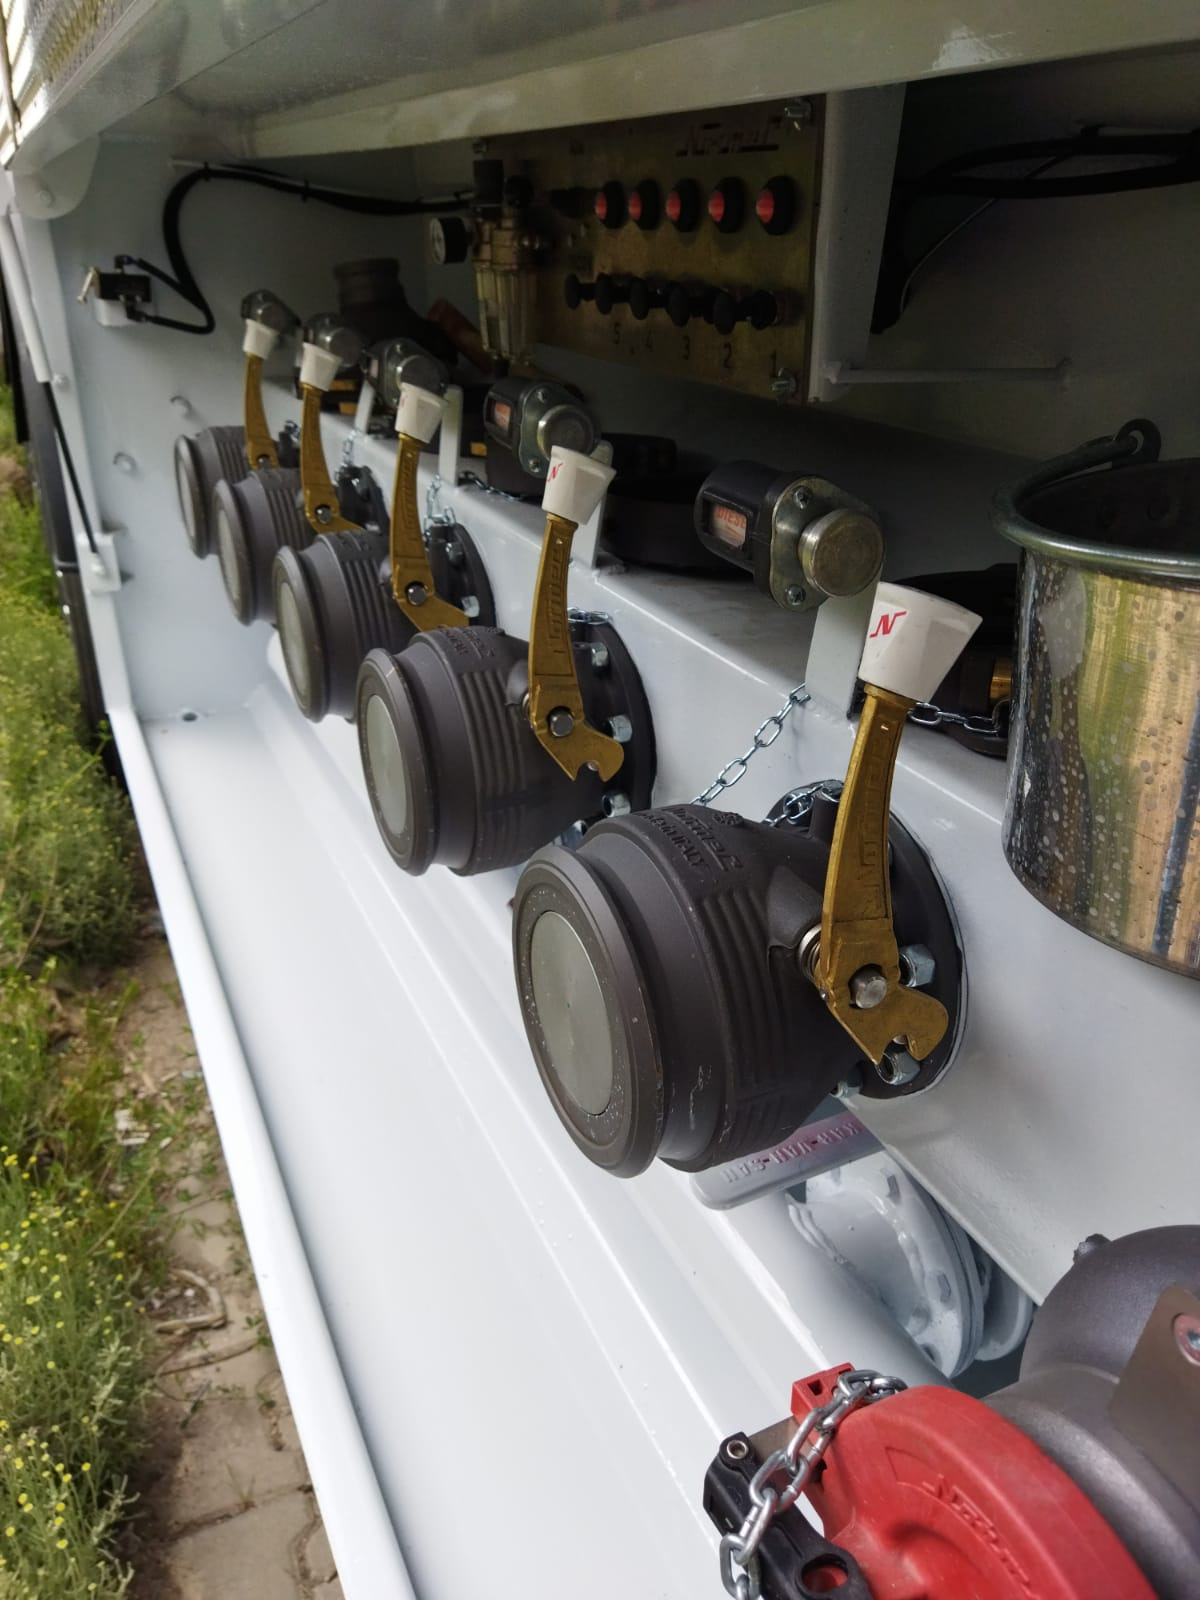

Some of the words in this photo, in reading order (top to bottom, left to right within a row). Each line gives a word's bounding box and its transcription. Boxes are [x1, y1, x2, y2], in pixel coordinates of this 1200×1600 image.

[681, 335, 691, 361] 3
[722, 341, 733, 369] 2
[869, 611, 907, 638] N
